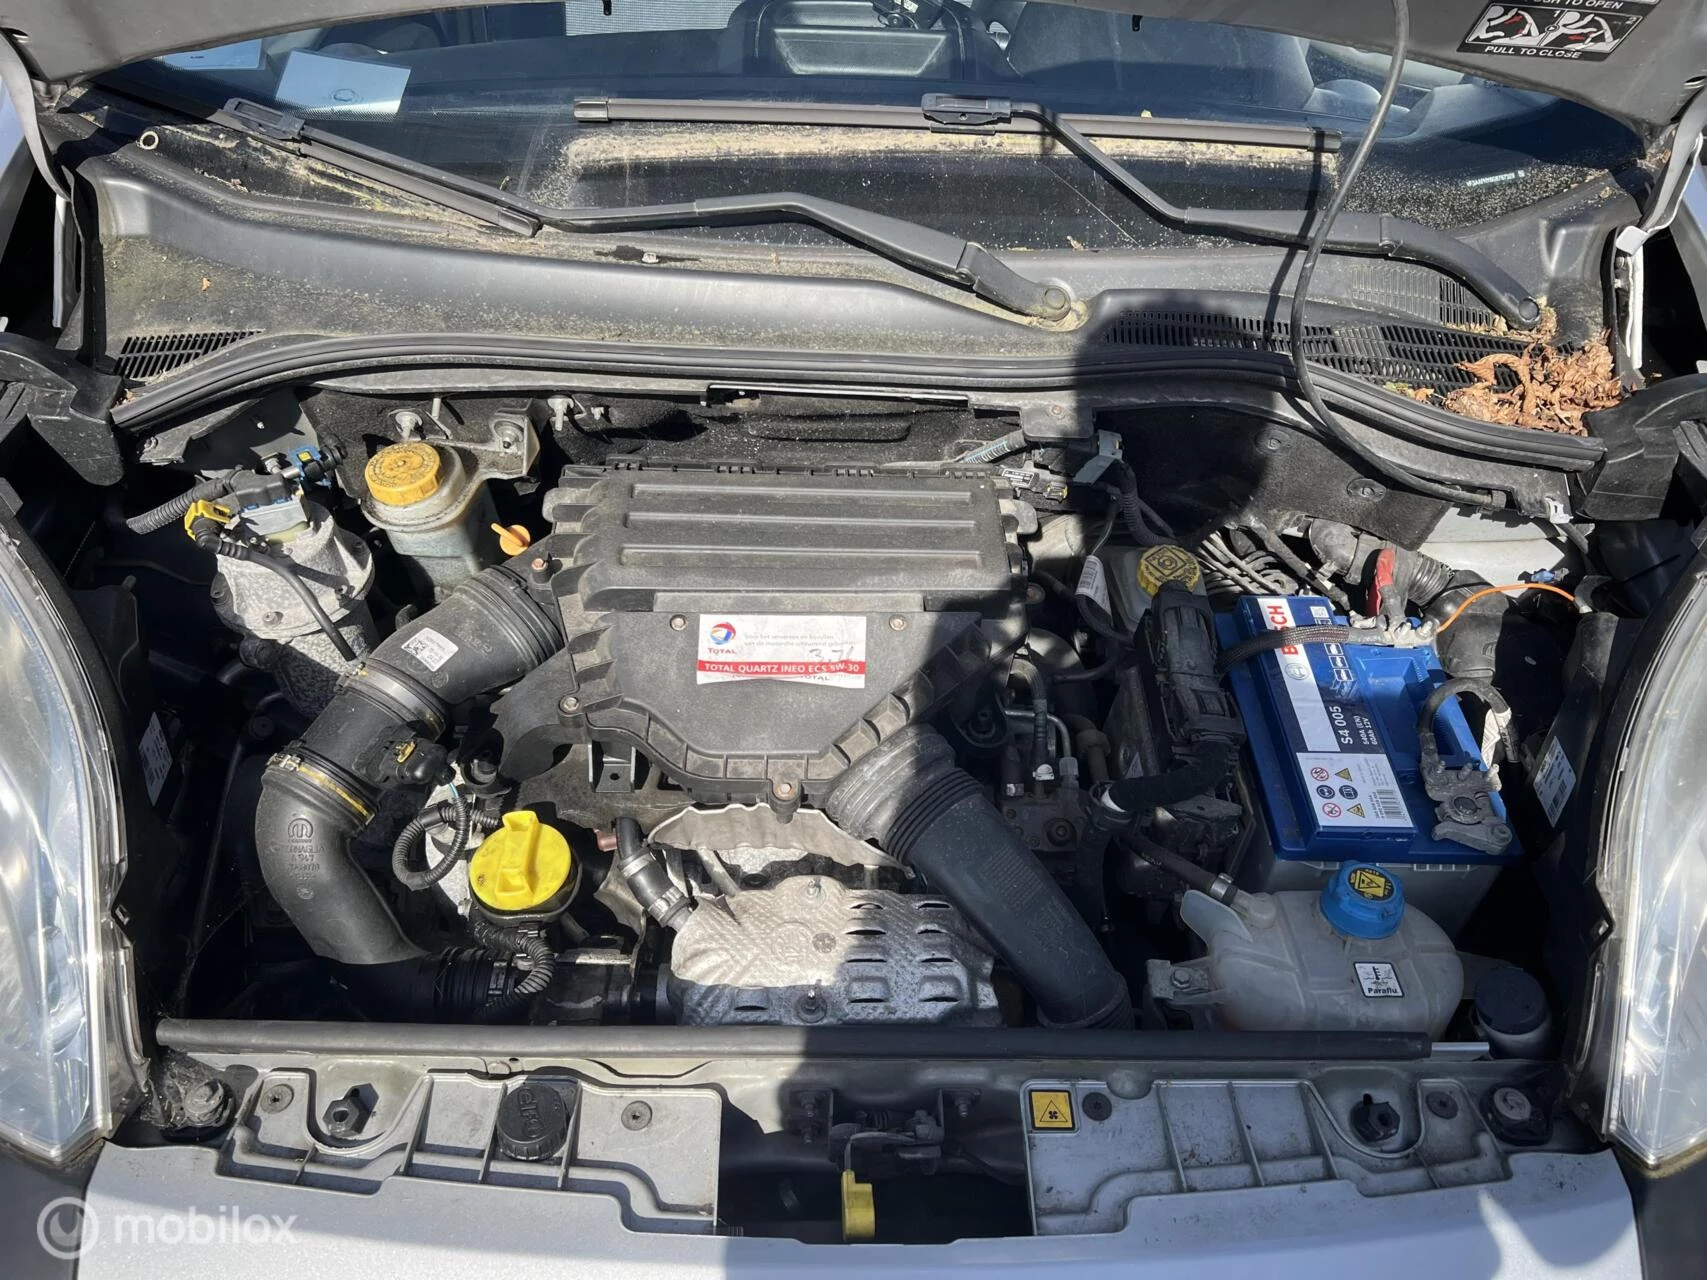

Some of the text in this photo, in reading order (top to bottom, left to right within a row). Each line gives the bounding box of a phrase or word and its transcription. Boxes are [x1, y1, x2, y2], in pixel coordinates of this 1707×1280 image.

[1585, 0, 1624, 10] OPEN
[1553, 10, 1561, 18] 1
[1625, 16, 1638, 25] 2
[1484, 45, 1583, 60] PULL TO CLOSE
[1266, 605, 1299, 655] BCH
[707, 647, 737, 655] TOTAL
[704, 662, 735, 673] TOTAL
[738, 663, 779, 674] QUARTZ
[780, 665, 806, 674] INEO
[808, 665, 827, 673] ECS
[1329, 705, 1354, 745] S4 005
[1361, 716, 1373, 729] 12V
